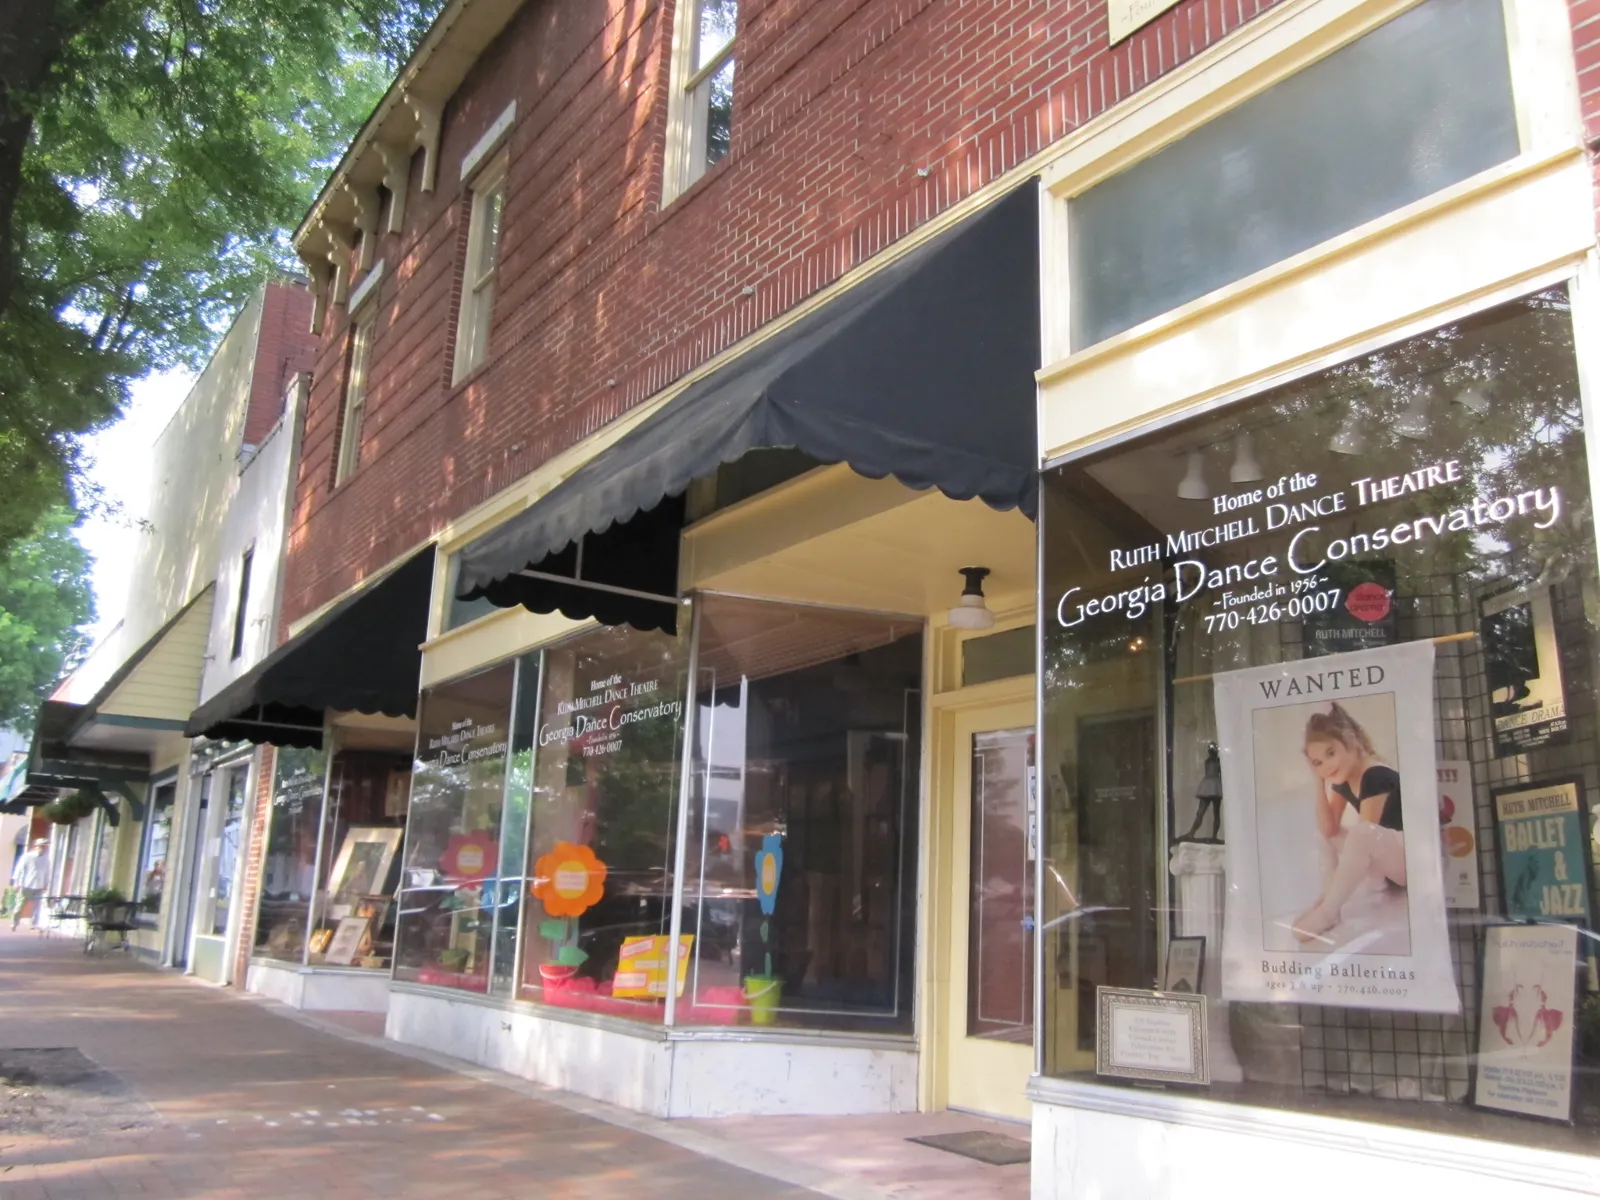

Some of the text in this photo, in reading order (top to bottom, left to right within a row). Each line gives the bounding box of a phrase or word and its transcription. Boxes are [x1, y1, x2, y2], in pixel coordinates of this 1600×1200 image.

[1213, 472, 1317, 514] Home of the
[1110, 460, 1462, 571] RUTH MITCHELL DANCE THEATRE
[1057, 485, 1560, 627] Georgia Dance Conservatory
[1275, 583, 1286, 596] in
[1205, 588, 1341, 634] 770-426-0007
[1315, 627, 1387, 639] RUTH MITCHELL
[604, 687, 628, 704] DANCE
[630, 680, 659, 697] THEATRE
[1259, 665, 1385, 699] WANTED
[539, 723, 574, 746] Georgia
[576, 715, 607, 739] Dance
[609, 700, 682, 731] Conservatory
[461, 742, 507, 764] Conservatory
[1528, 792, 1572, 812] MITCHELL
[1504, 817, 1566, 852] BALLET
[1554, 850, 1568, 881] &
[1540, 884, 1585, 915] JAZZ
[1261, 960, 1415, 980] Budding Ballerinas
